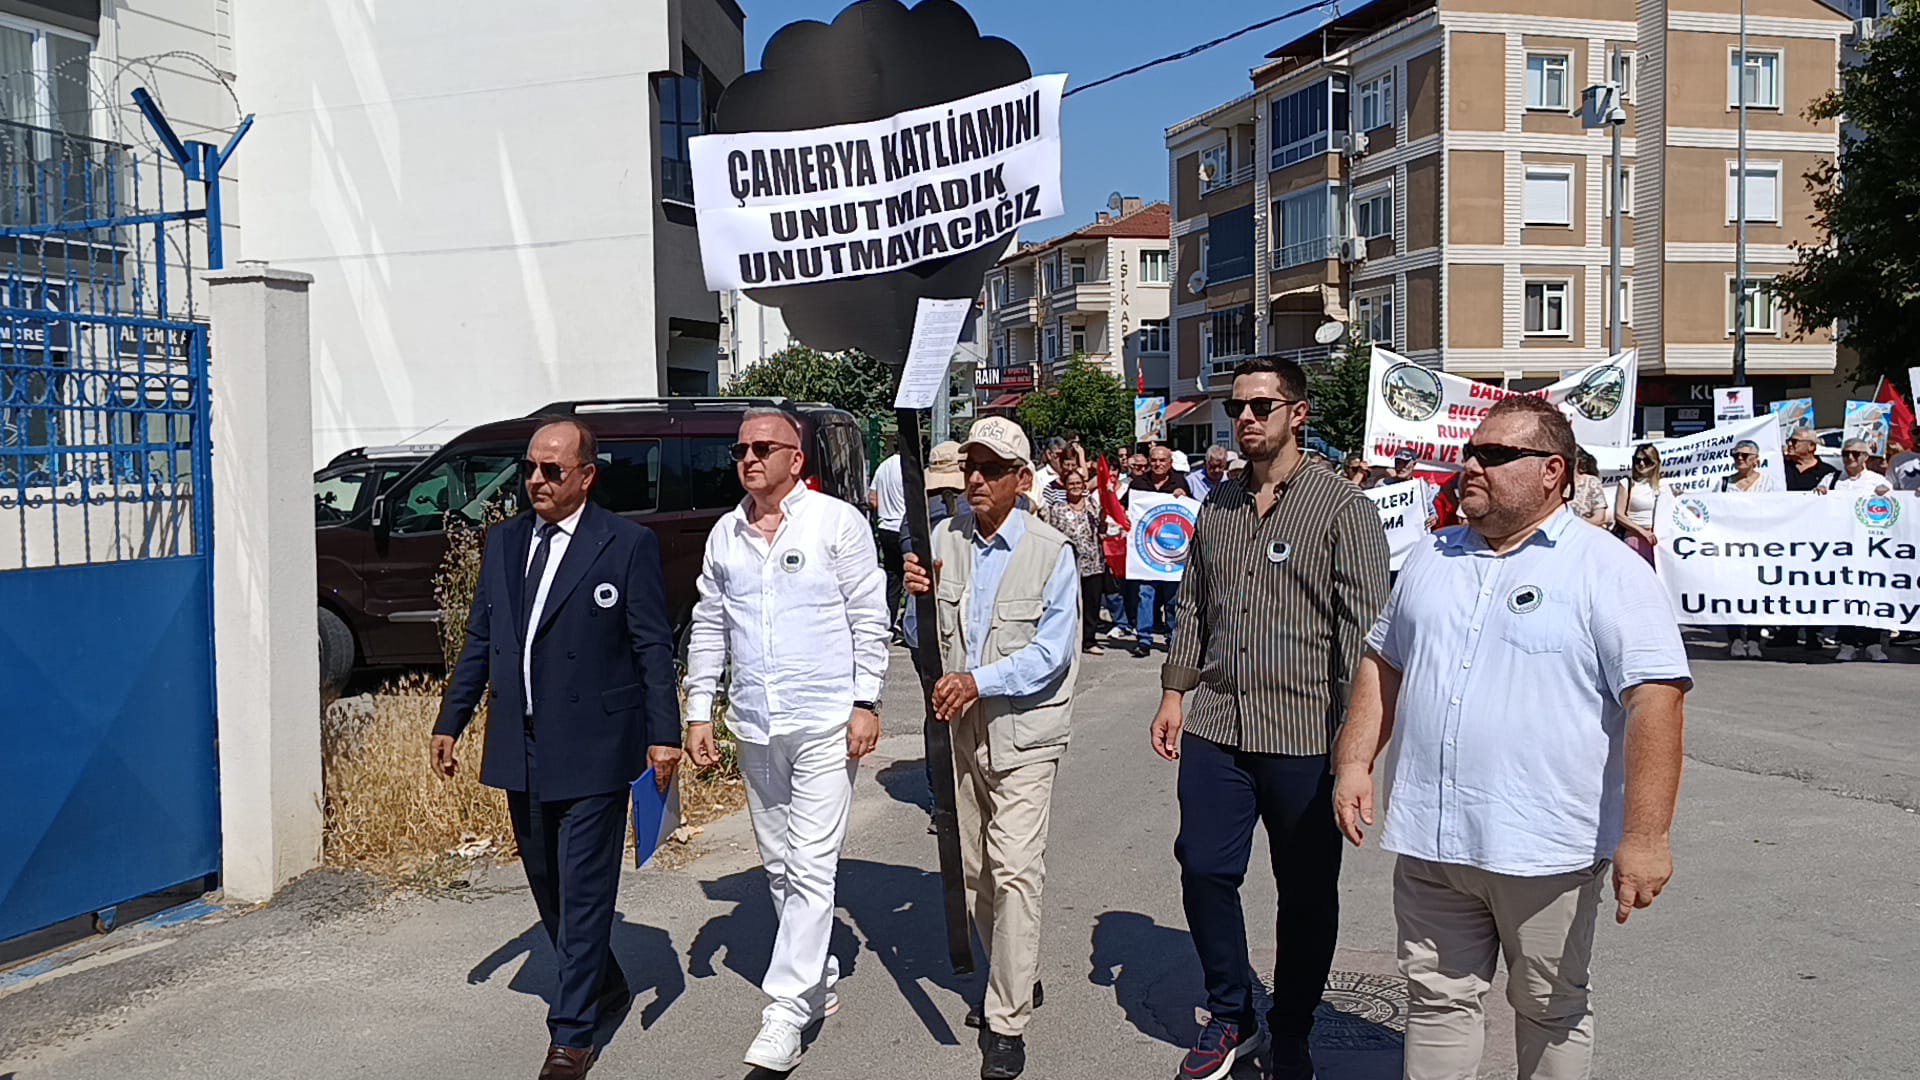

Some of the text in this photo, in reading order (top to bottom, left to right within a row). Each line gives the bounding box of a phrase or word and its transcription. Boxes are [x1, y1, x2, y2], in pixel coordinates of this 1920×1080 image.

[728, 90, 1041, 208] ÇAMERYA KATLİAMINI
[770, 163, 1006, 242] UNUTMADIK
[739, 185, 1042, 284] UNUTMAYACAĞIZ
[1439, 444, 1460, 464] VE
[1672, 537, 1853, 562] Çamerya
[1757, 566, 1920, 590] Unutma
